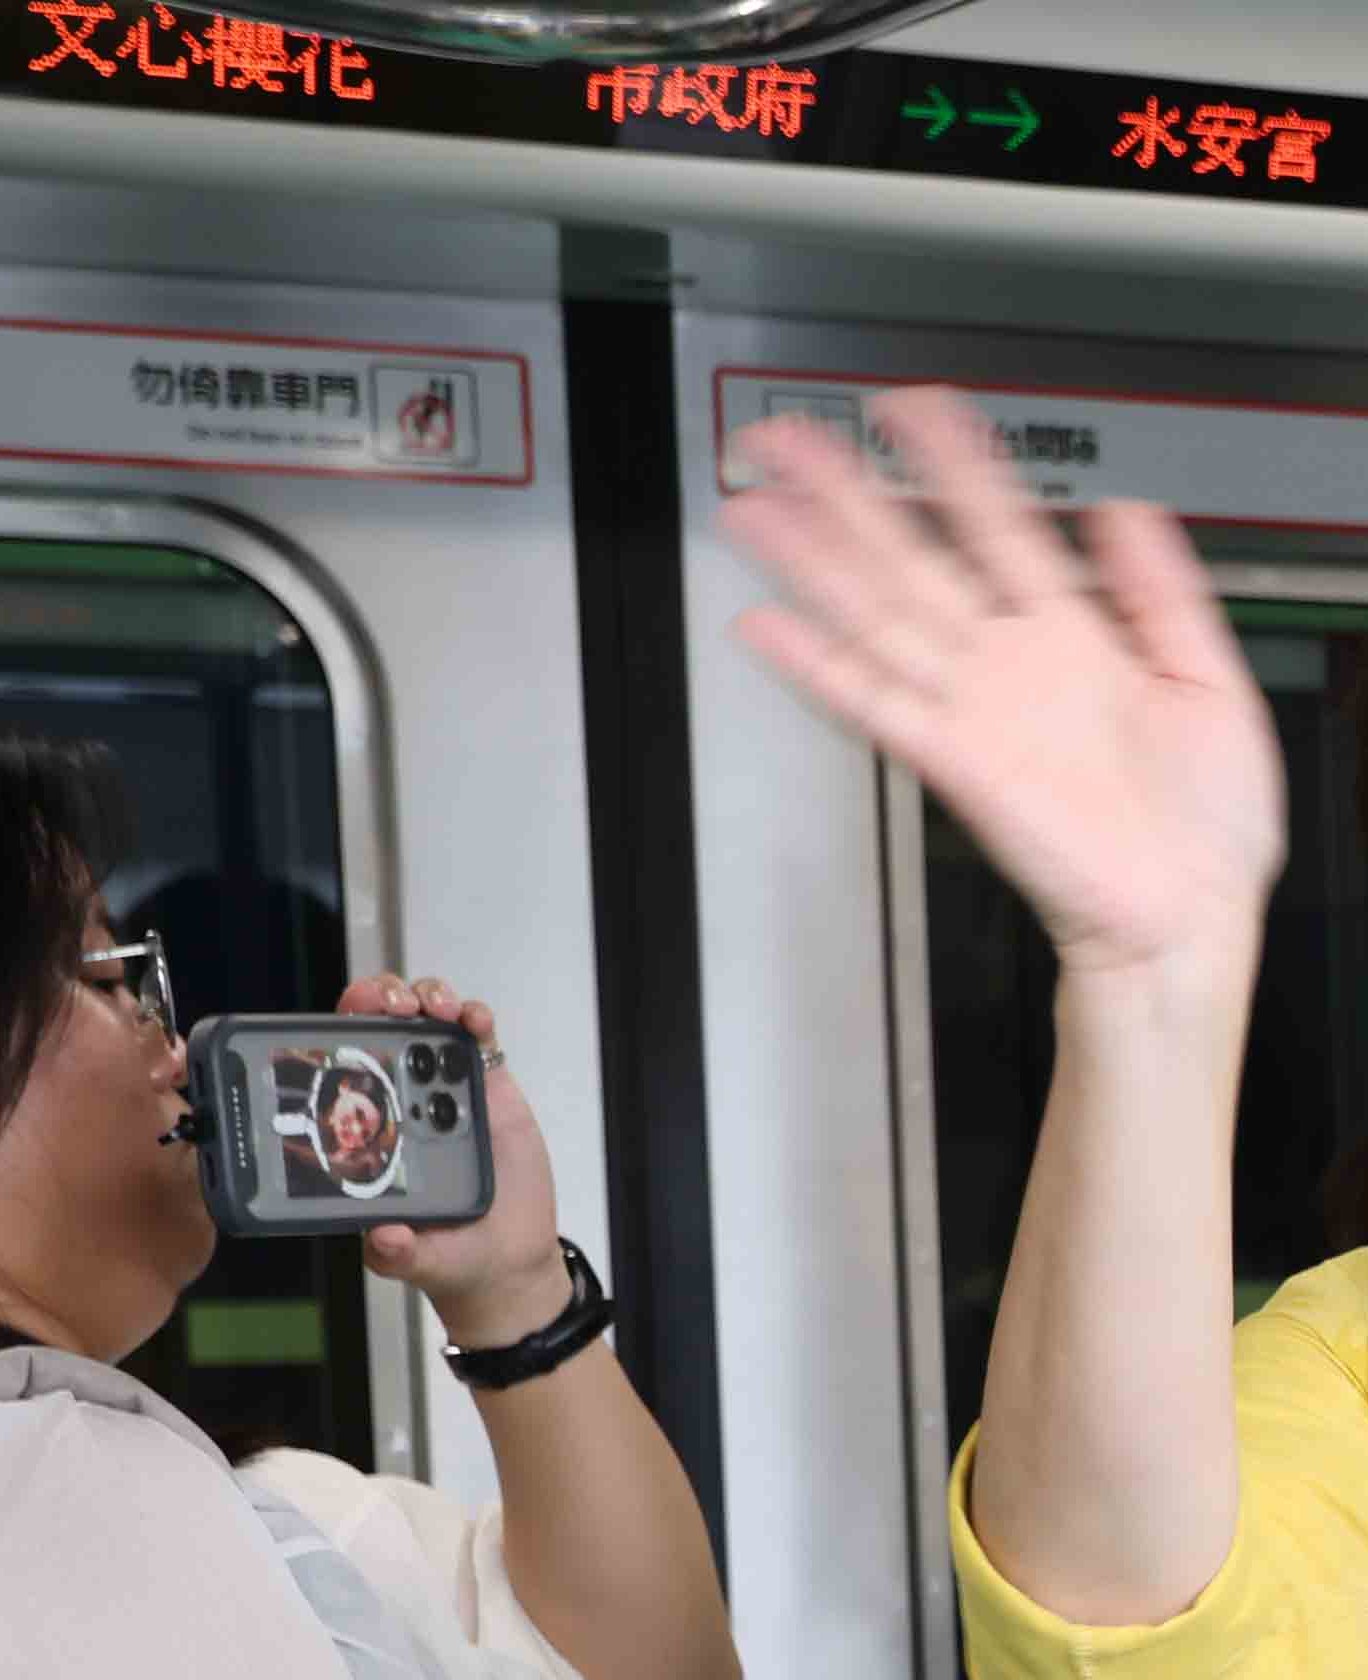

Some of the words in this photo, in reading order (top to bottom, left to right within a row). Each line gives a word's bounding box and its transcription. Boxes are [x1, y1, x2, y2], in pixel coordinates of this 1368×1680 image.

[27, 0, 375, 101] 文心櫻花
[587, 60, 818, 138] 市政府
[1111, 95, 1333, 185] 水安宮
[133, 358, 361, 418] 勿倚靠車門
